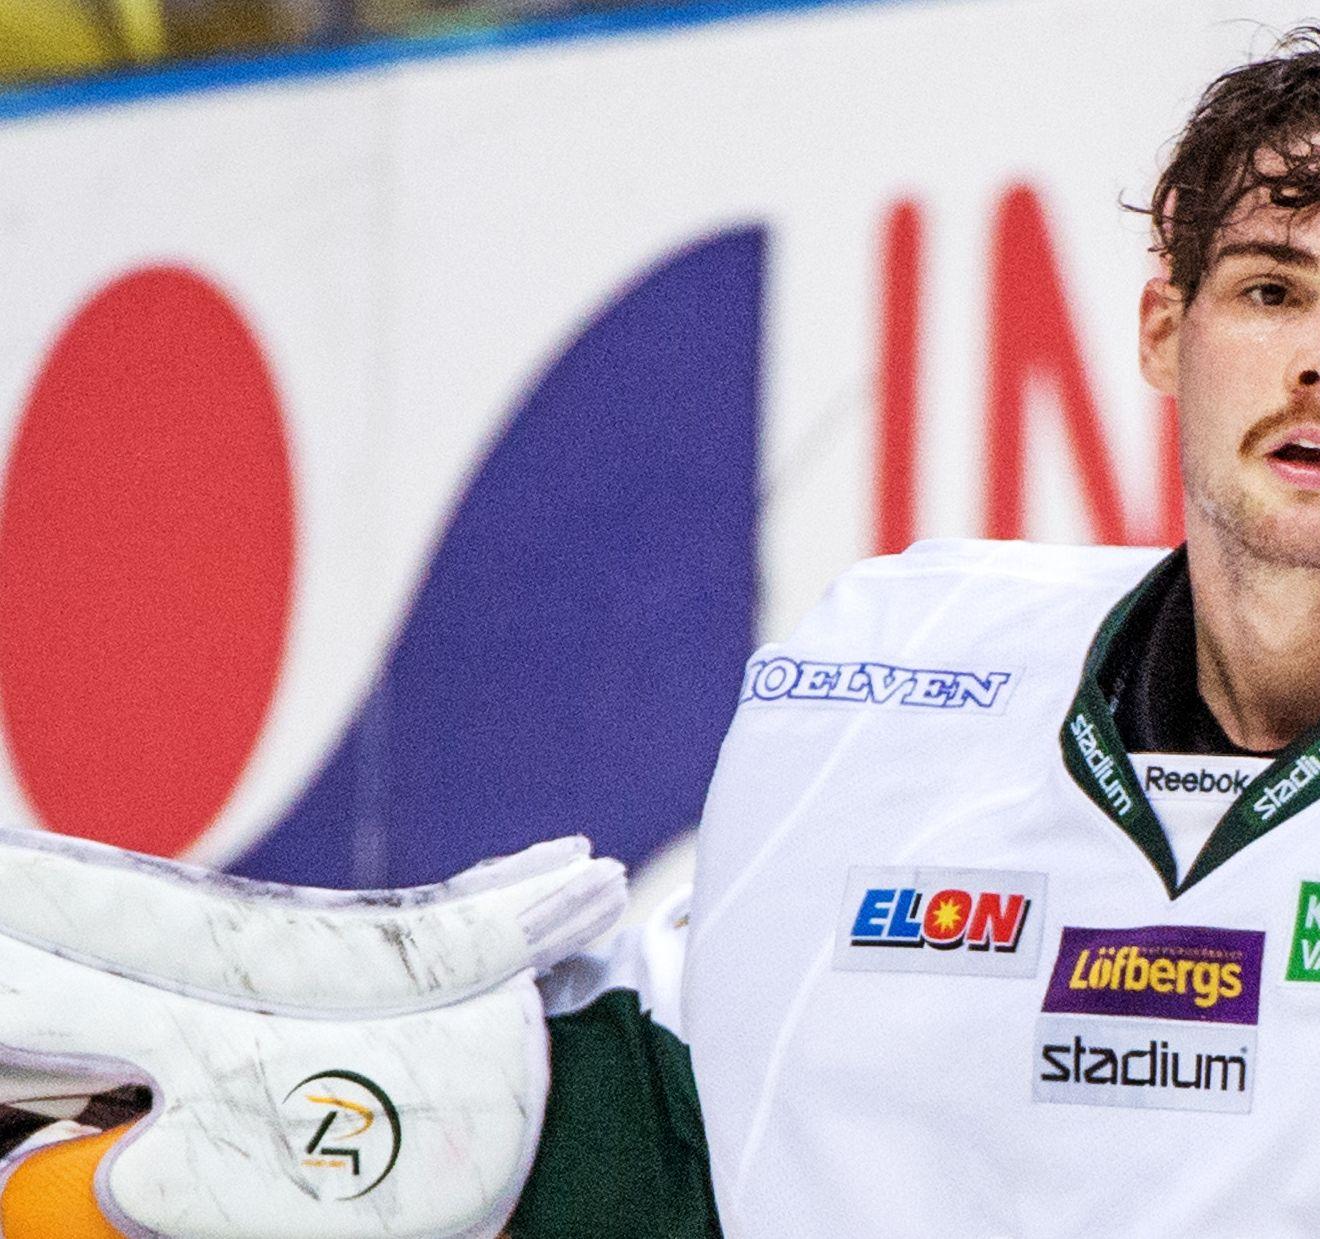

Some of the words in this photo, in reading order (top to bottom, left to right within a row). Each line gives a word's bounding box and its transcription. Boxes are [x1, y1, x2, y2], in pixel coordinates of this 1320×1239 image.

[1070, 714, 1132, 816] stadium
[1145, 766, 1250, 794] Reebok
[850, 888, 1031, 952] ELON
[1069, 946, 1243, 1008] Löfbergs
[1041, 1035, 1247, 1092] stadium
